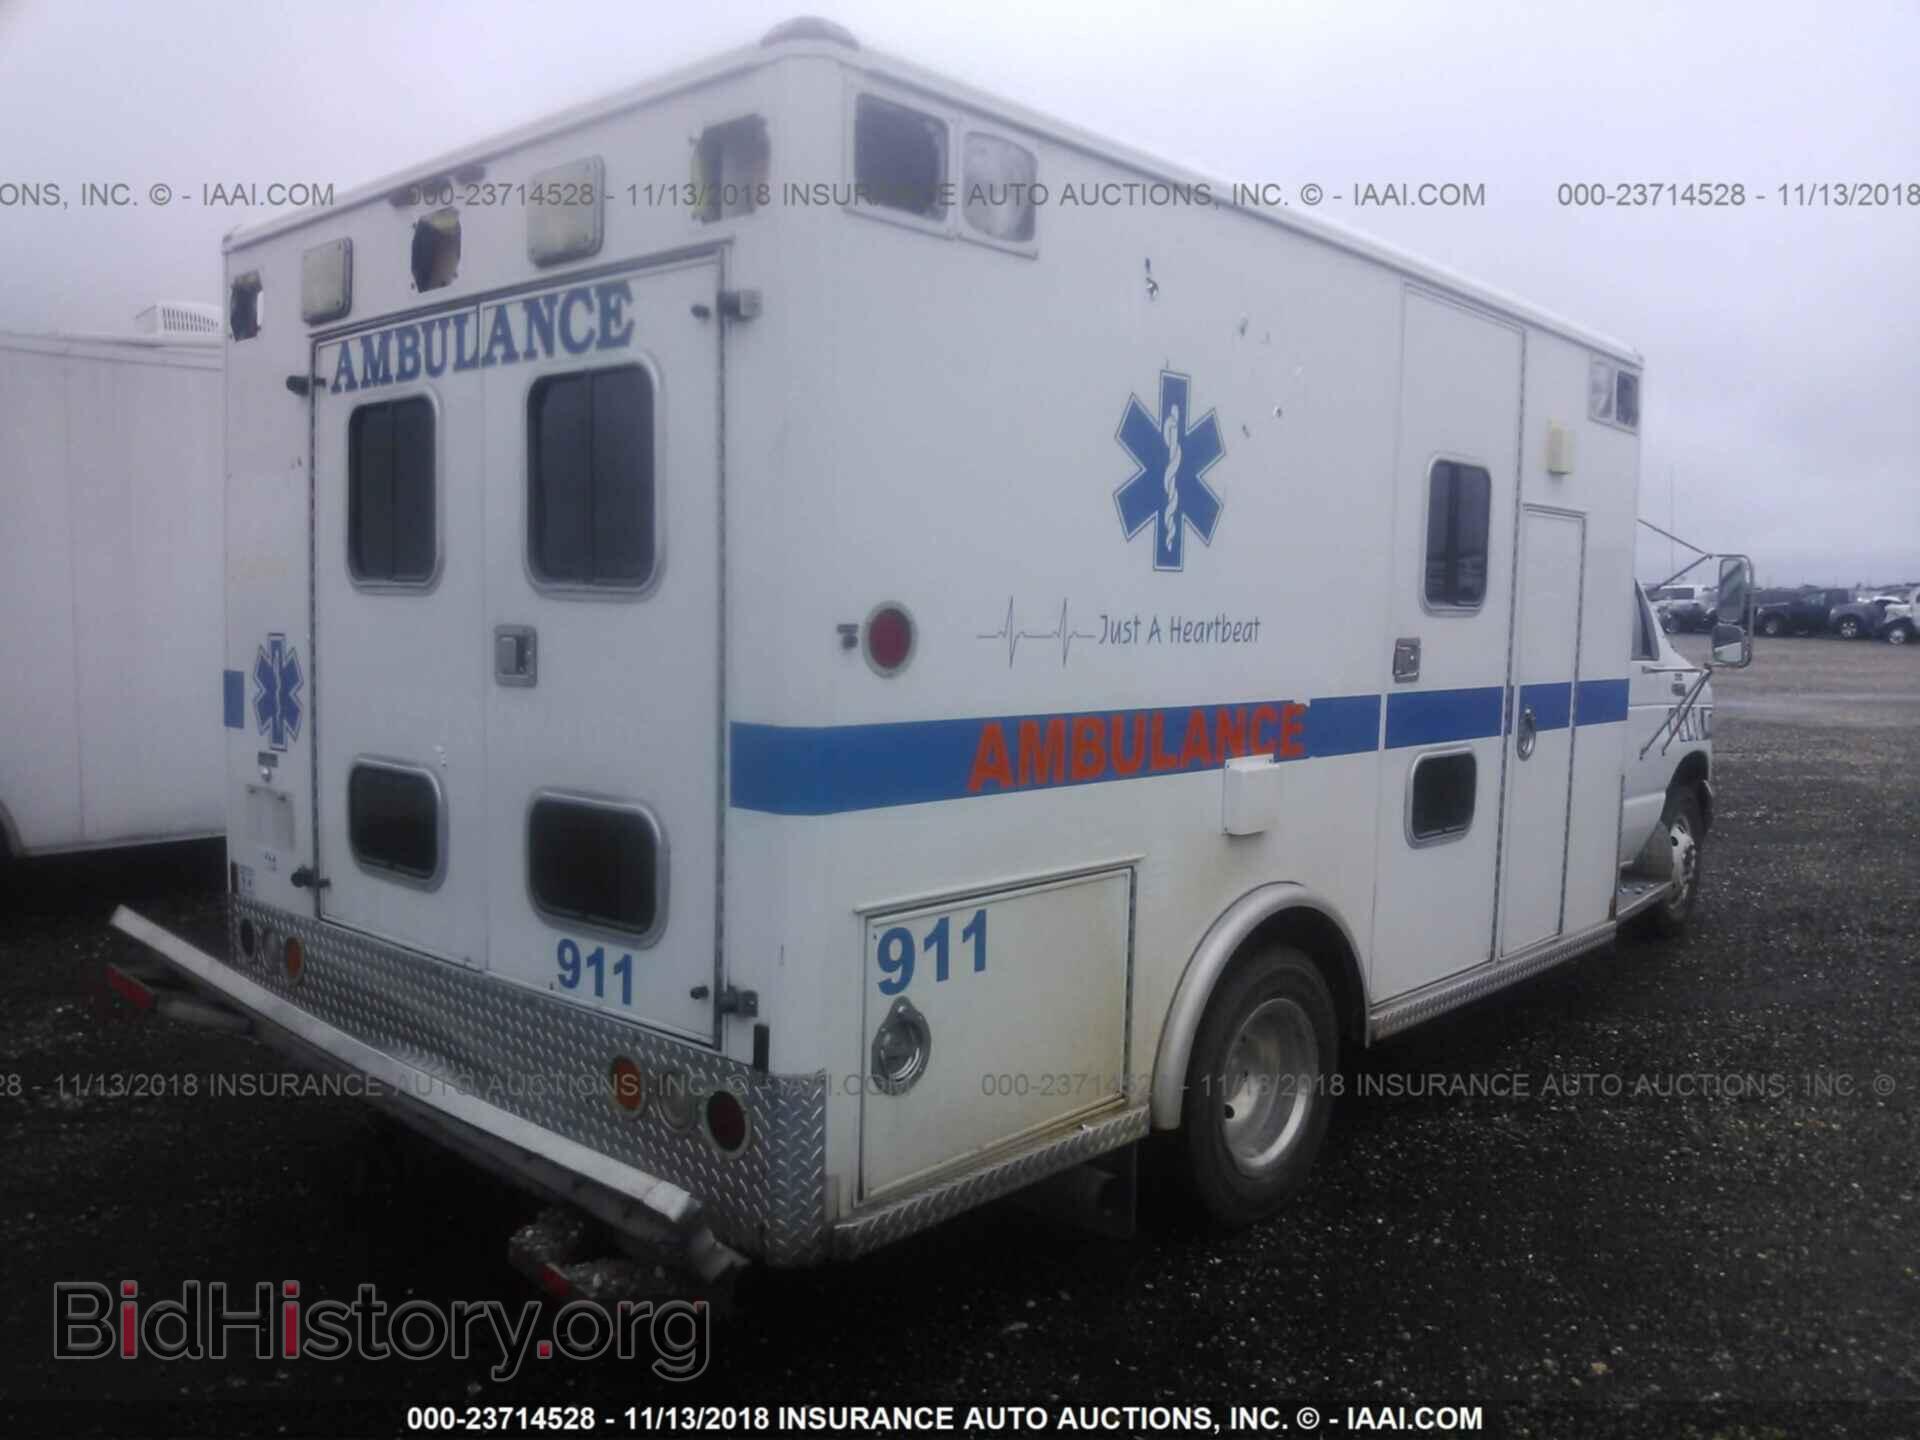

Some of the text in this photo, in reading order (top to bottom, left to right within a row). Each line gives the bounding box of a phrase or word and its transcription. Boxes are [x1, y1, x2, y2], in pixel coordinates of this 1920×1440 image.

[331, 280, 635, 394] AMBULANCE
[1099, 613, 1261, 645] Just A Heartbeat
[967, 703, 1308, 791] AMBULANCE
[557, 938, 632, 1005] 911
[877, 909, 987, 996] 911
